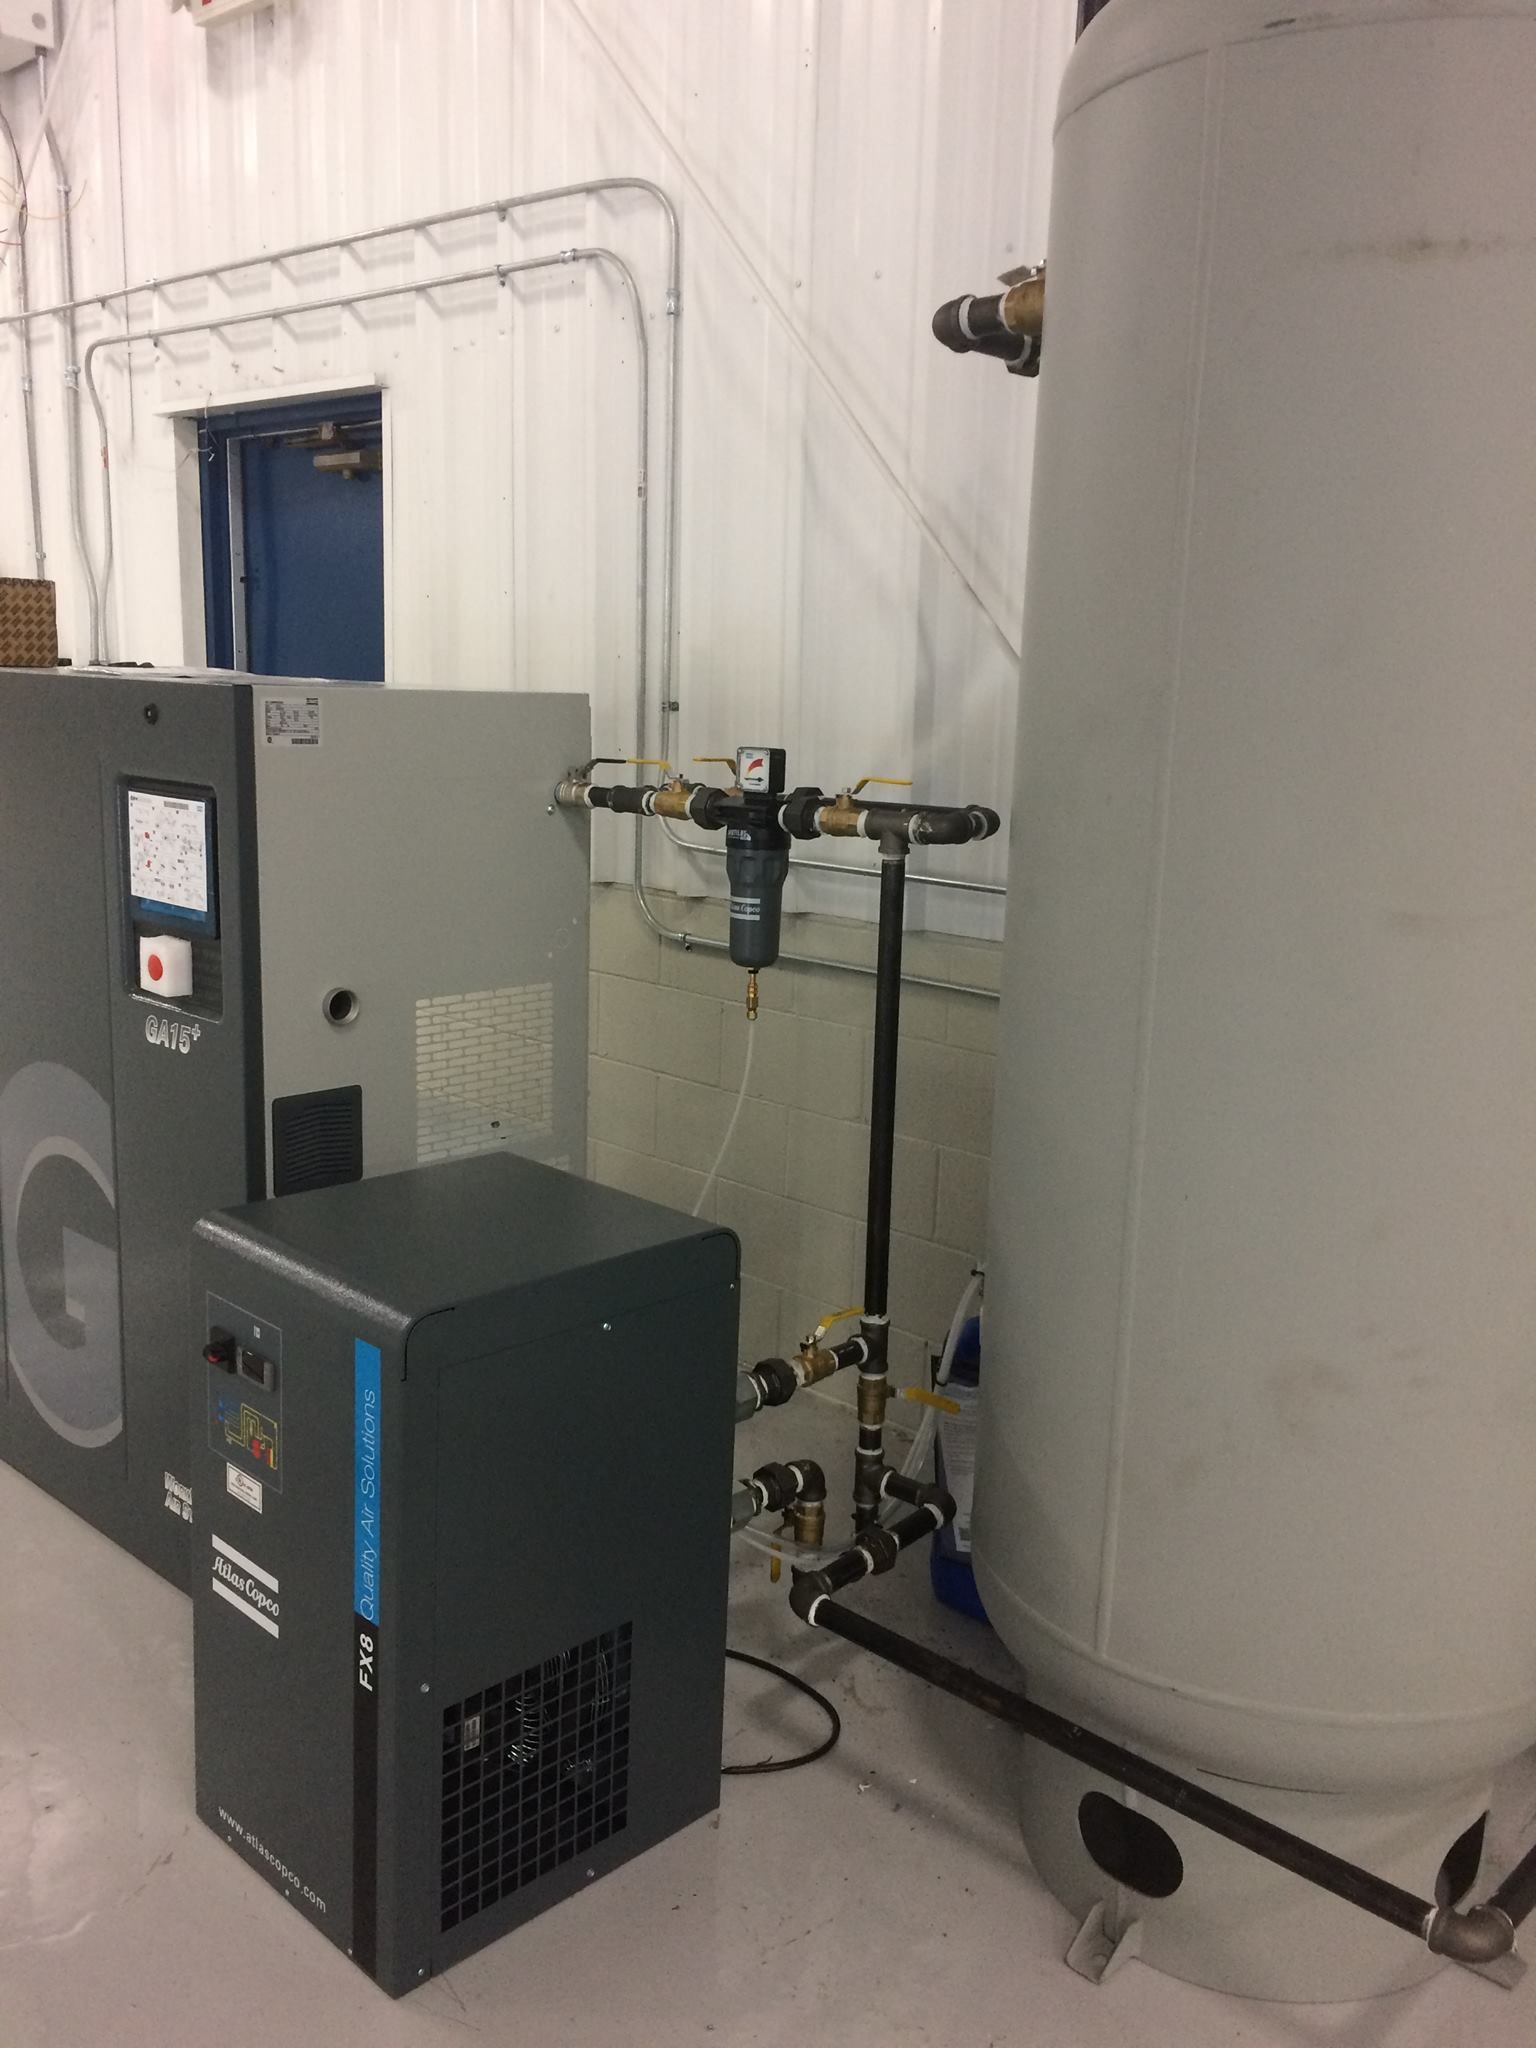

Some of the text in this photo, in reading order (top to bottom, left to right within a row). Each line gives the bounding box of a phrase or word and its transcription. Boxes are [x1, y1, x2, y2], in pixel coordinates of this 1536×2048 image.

[360, 1389, 377, 1621] Quality Air Solutions
[212, 1556, 280, 1616] Atlas Copco
[359, 1633, 374, 1692] FX8
[218, 1806, 326, 1913] www.atlascopco.com
